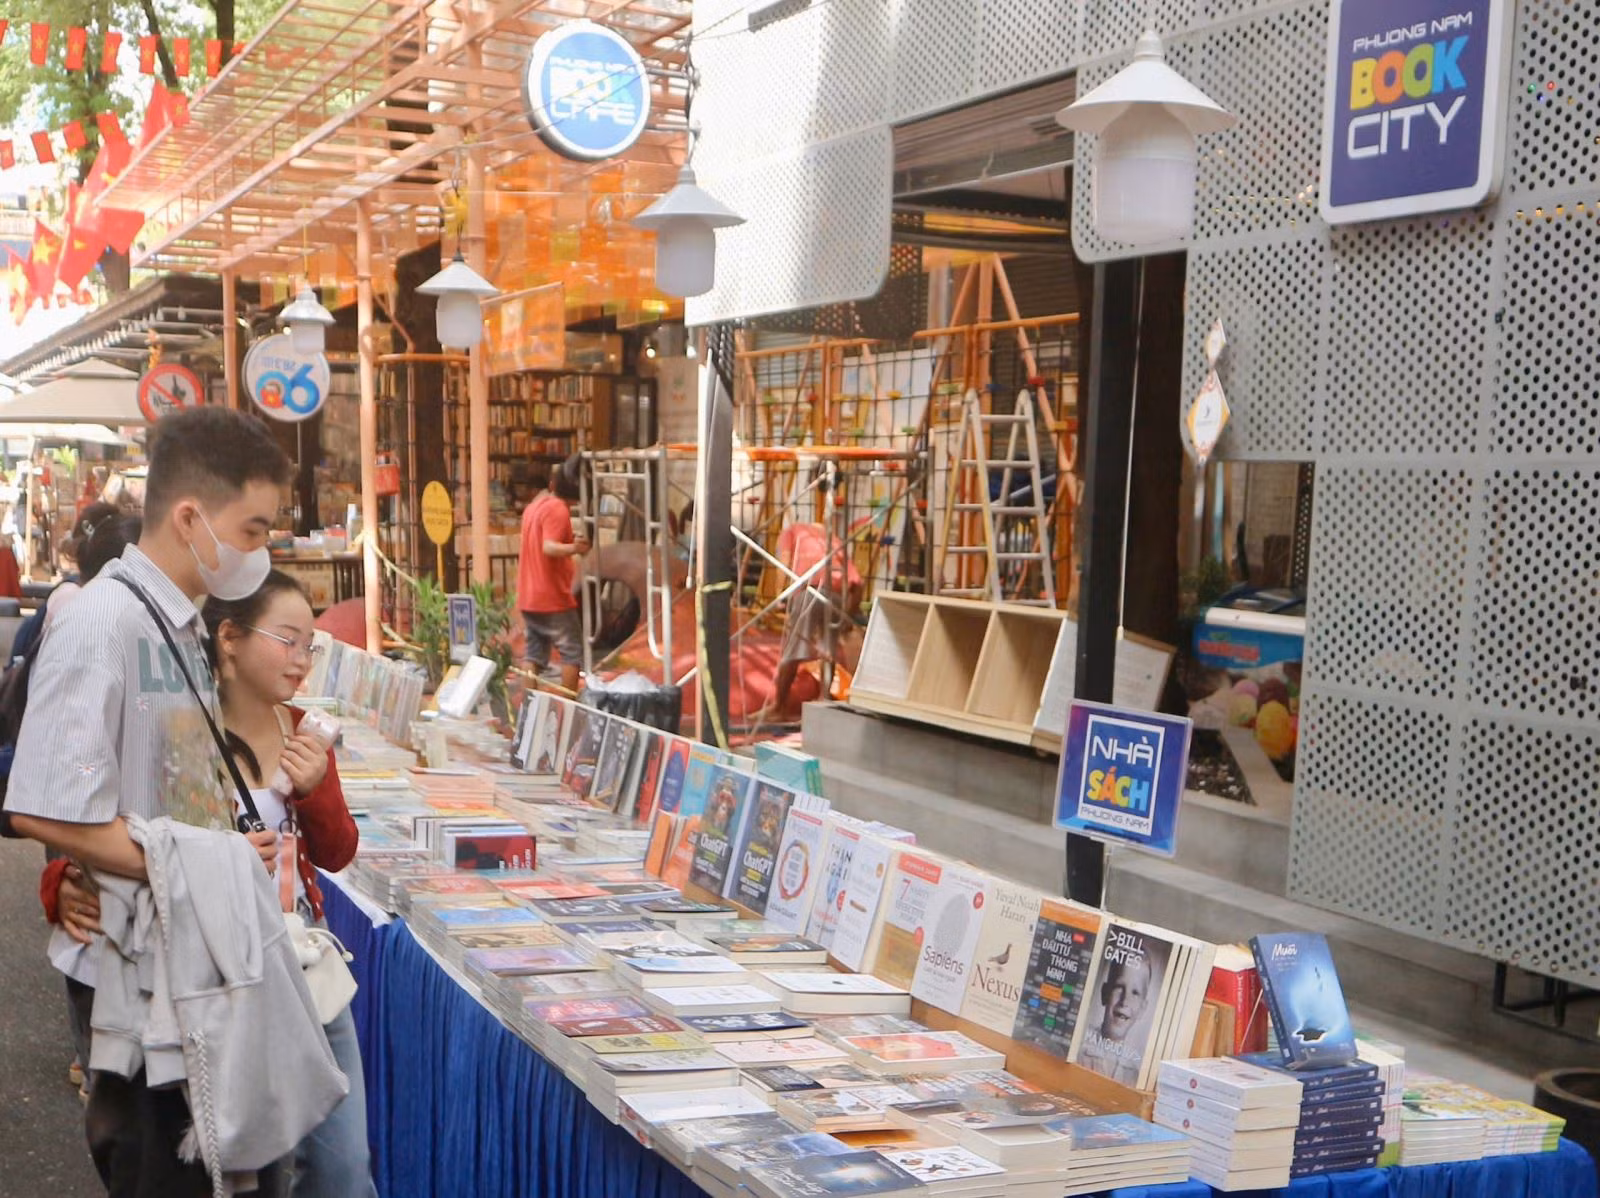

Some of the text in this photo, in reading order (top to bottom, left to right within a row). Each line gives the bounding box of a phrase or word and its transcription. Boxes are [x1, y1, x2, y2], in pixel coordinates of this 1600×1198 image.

[1353, 12, 1472, 53] PHUONG NAM
[1350, 35, 1469, 110] BOOK
[1347, 95, 1466, 159] CITY
[1092, 736, 1153, 768] NHÀ
[1087, 766, 1149, 811] SÁCH
[1125, 816, 1149, 829] NAM
[701, 832, 728, 857] ChatGPT
[743, 851, 773, 876] ChatGPT
[924, 945, 964, 976] Sapiens
[1104, 946, 1142, 970] GATES
[972, 963, 1020, 1002] Nexus
